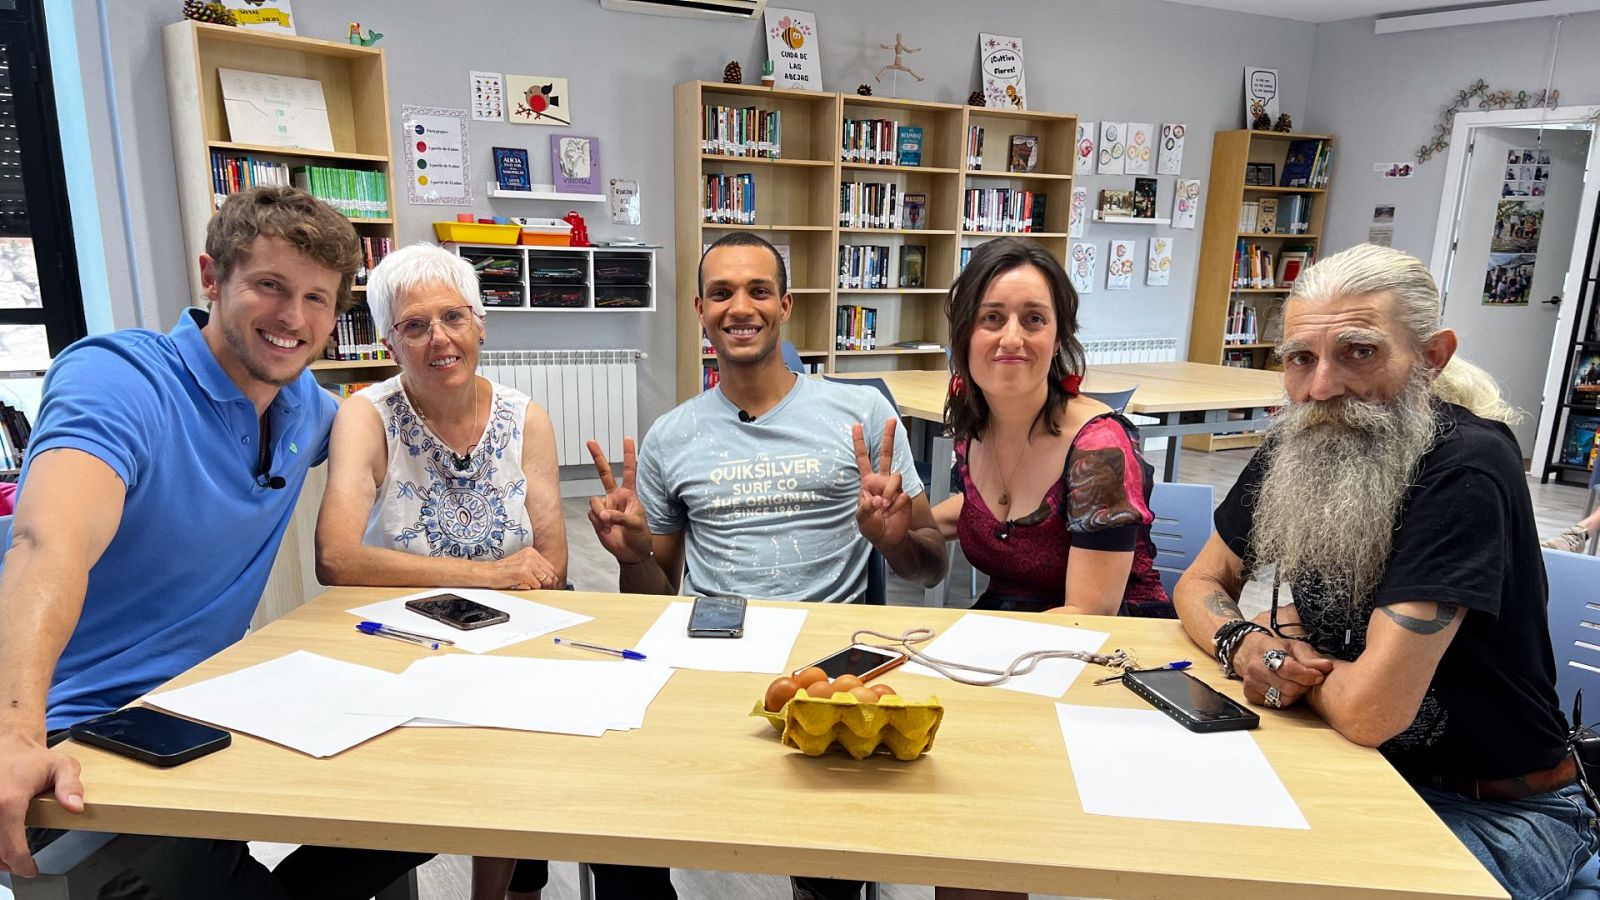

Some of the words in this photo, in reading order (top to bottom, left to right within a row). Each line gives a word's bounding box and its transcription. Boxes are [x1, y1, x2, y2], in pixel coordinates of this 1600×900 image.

[781, 50, 799, 59] CUIDA
[799, 52, 808, 60] DE
[990, 54, 1015, 64] ¡Cultiva
[788, 62, 802, 71] LAS
[784, 72, 809, 82] ABEJAS
[709, 458, 820, 485] QUIKSILVER
[732, 480, 772, 496] SURF
[777, 478, 798, 491] CO
[733, 507, 770, 518] SINCE
